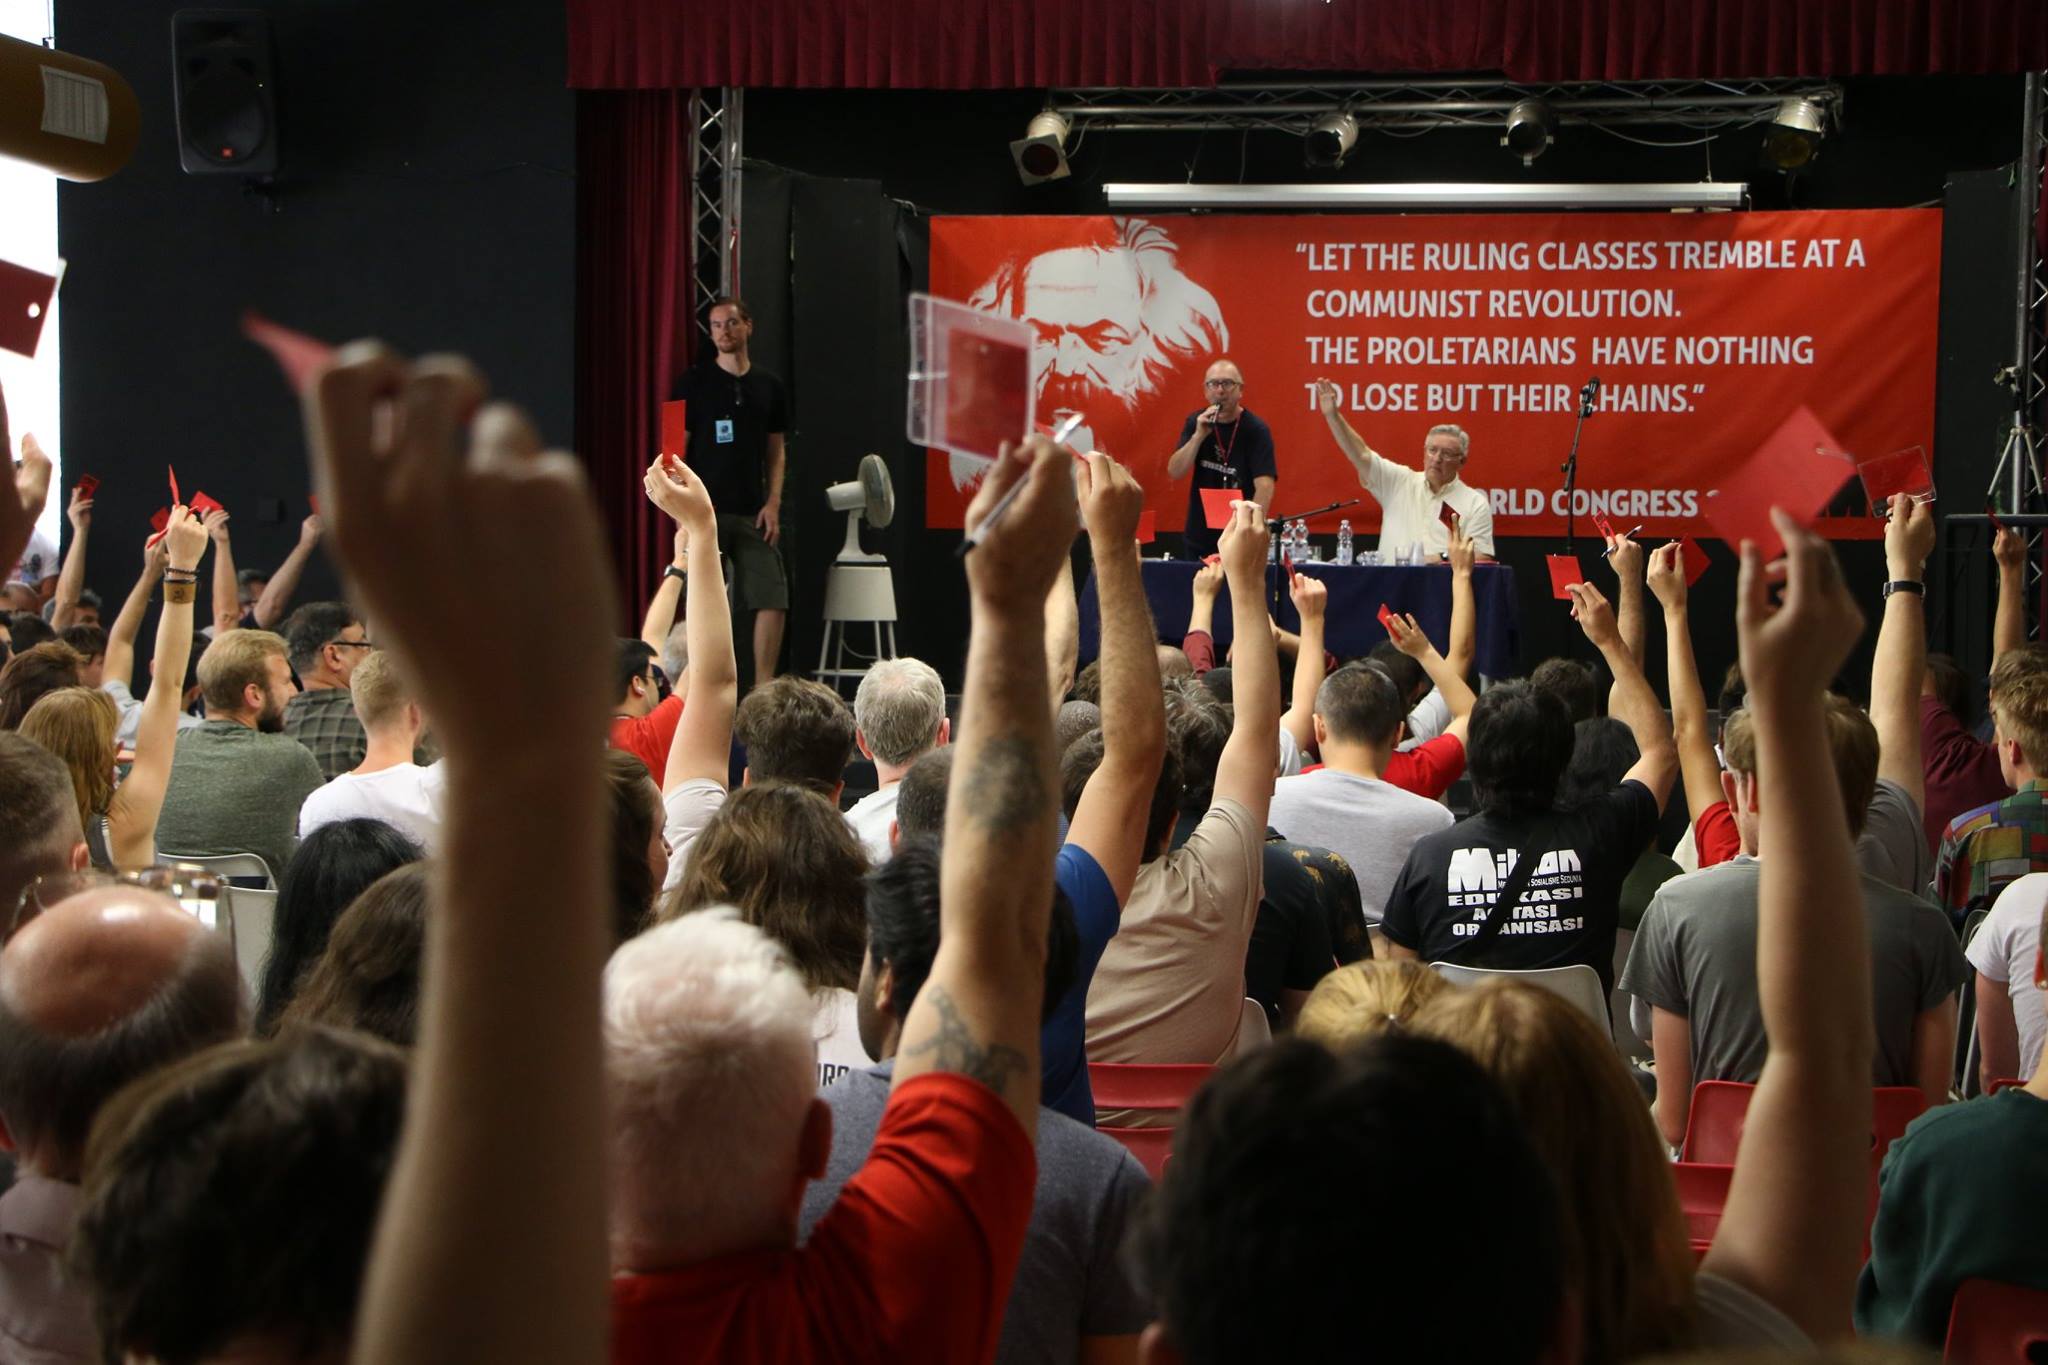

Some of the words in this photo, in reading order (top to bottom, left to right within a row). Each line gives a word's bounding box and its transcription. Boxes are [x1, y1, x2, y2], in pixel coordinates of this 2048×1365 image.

[1295, 242, 1357, 271] “LET
[1360, 242, 1416, 271] THE
[1423, 242, 1530, 271] RULING
[1537, 241, 1658, 271] CLASSES
[1663, 240, 1797, 270] TREMBLE
[1801, 238, 1841, 269] AT
[1844, 238, 1866, 268] A
[1306, 288, 1482, 318] COMMUNIST
[1488, 288, 1682, 318] REVOLUTION.
[1304, 336, 1359, 365] THE
[1366, 336, 1577, 365] PROLETARIANS
[1591, 336, 1667, 365] HAVE
[1675, 335, 1814, 365] NOTHING
[1351, 382, 1419, 412] LOSE
[1426, 382, 1483, 412] BUT
[1487, 382, 1572, 412] THEIR
[1577, 382, 1706, 412] HAINS.”
[1550, 487, 1698, 517] CONGRESS
[1452, 916, 1584, 936] ORANISASI
[1472, 904, 1558, 921] ATASI
